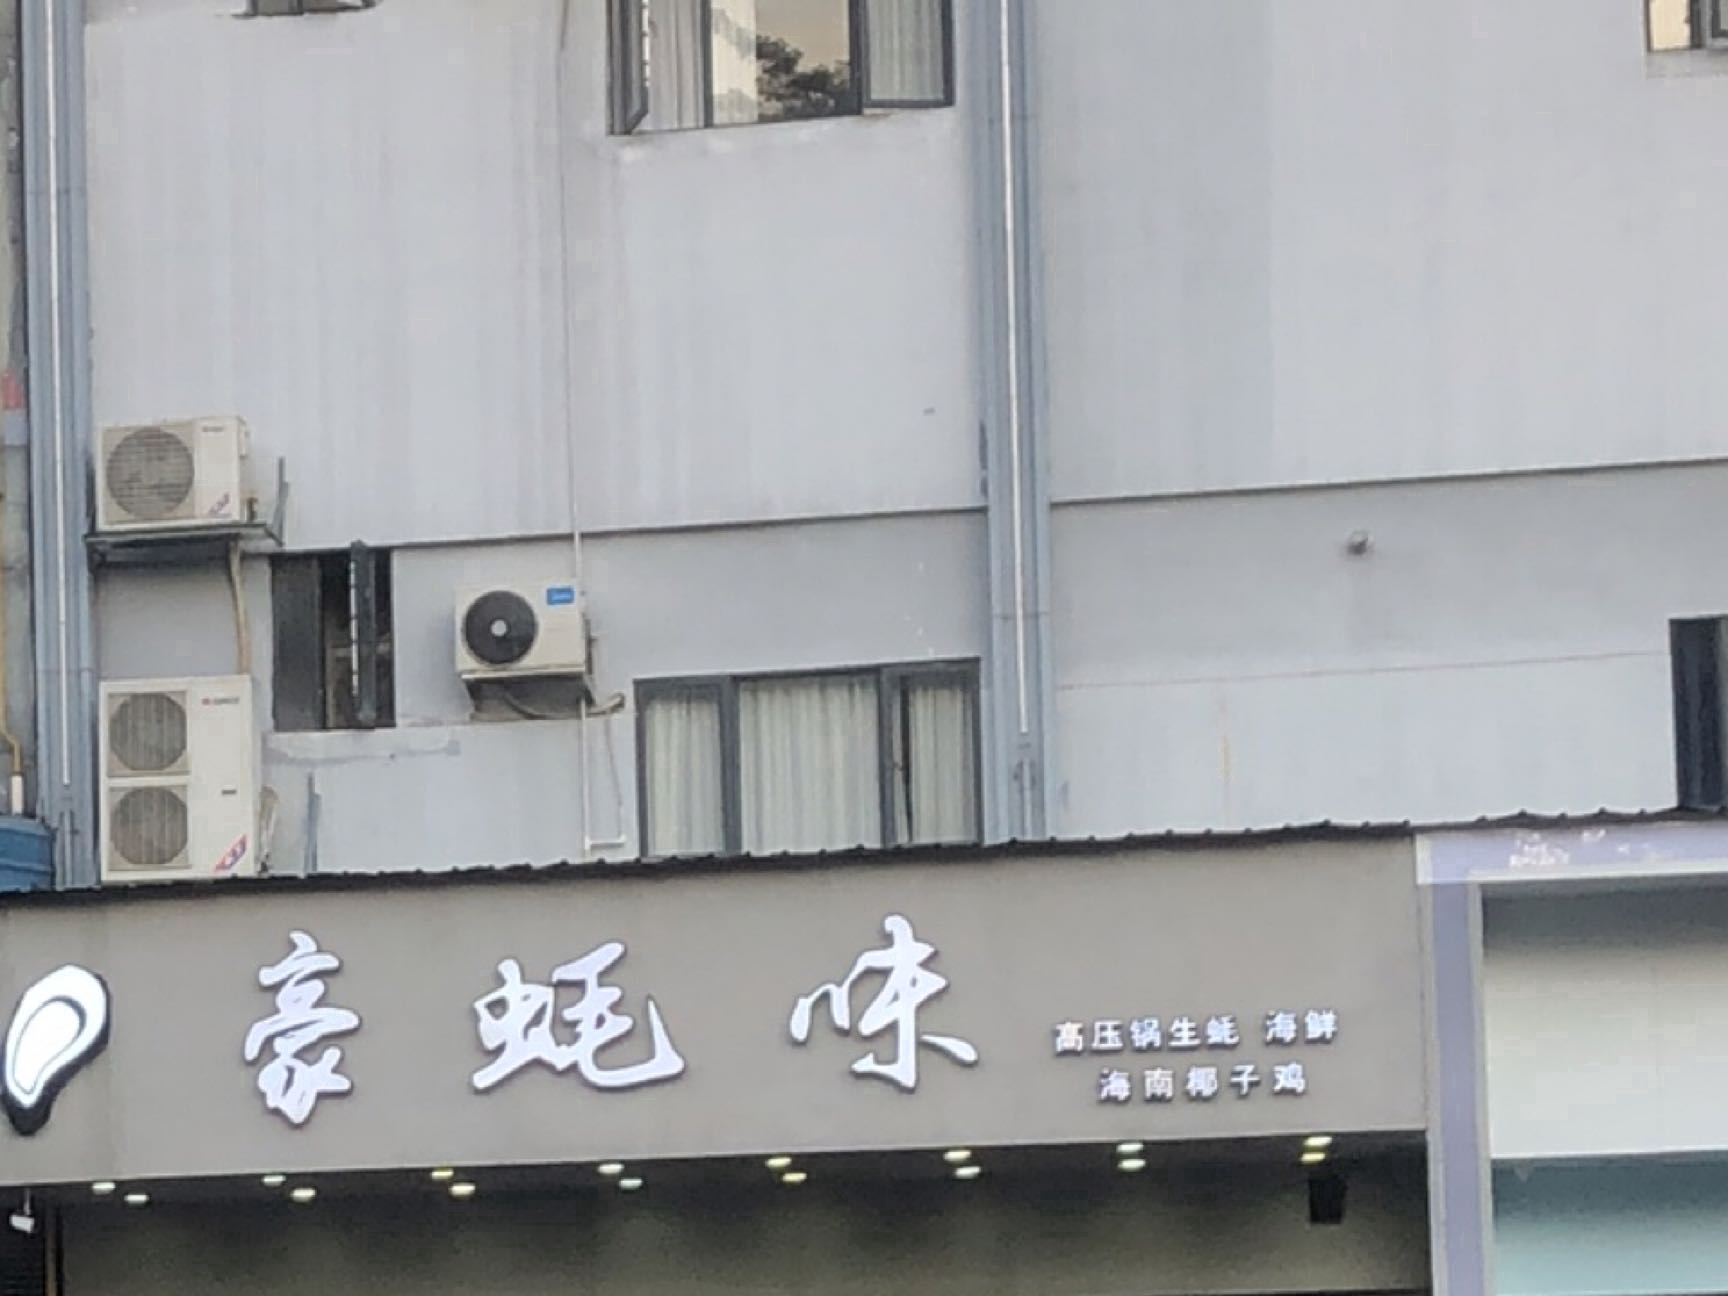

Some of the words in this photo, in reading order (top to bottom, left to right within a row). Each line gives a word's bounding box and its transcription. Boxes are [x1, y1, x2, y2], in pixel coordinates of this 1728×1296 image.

[1054, 1014, 1240, 1056] 高压锅生蚝
[1264, 1009, 1339, 1045] 海鲜
[1097, 1060, 1307, 1102] 海南椰子鸡
